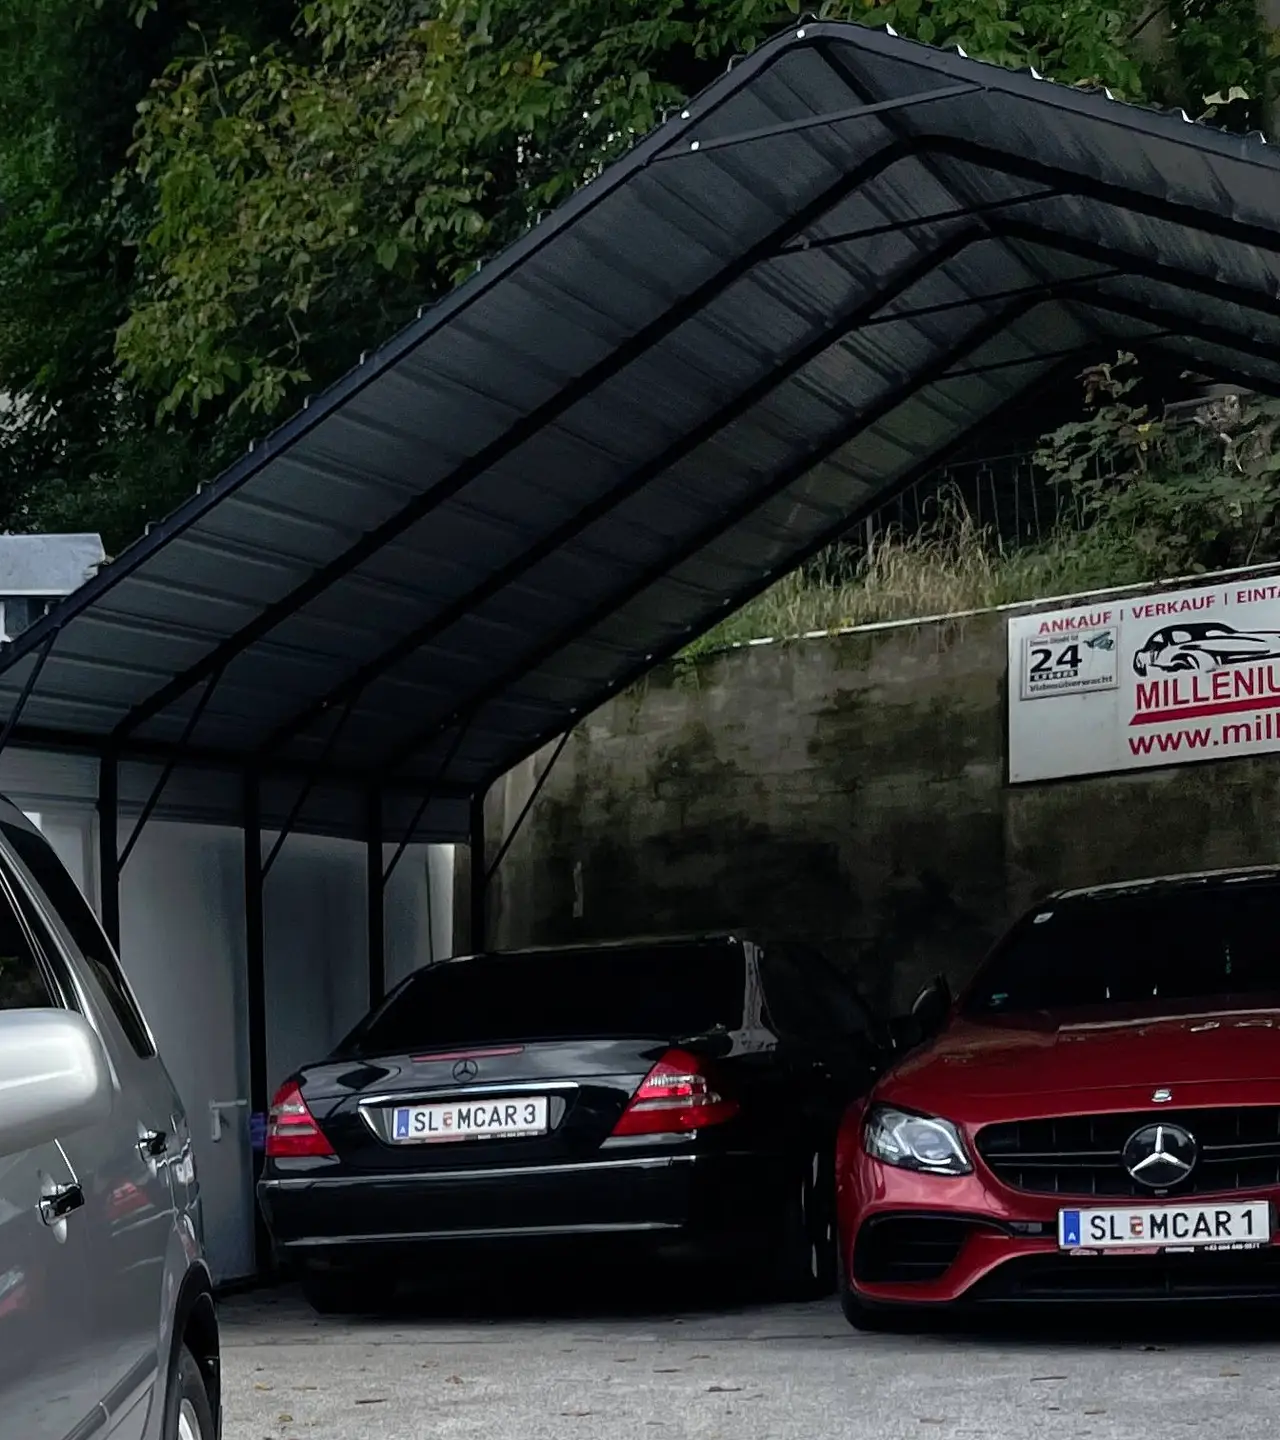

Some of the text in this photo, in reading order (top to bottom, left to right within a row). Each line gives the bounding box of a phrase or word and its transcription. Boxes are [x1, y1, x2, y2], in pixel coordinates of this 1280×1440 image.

[1039, 611, 1112, 635] ANKAUF
[1132, 595, 1215, 620] VERKAUF
[1029, 643, 1083, 676] 24
[414, 1111, 438, 1132] SL
[1090, 1215, 1124, 1241] SL
